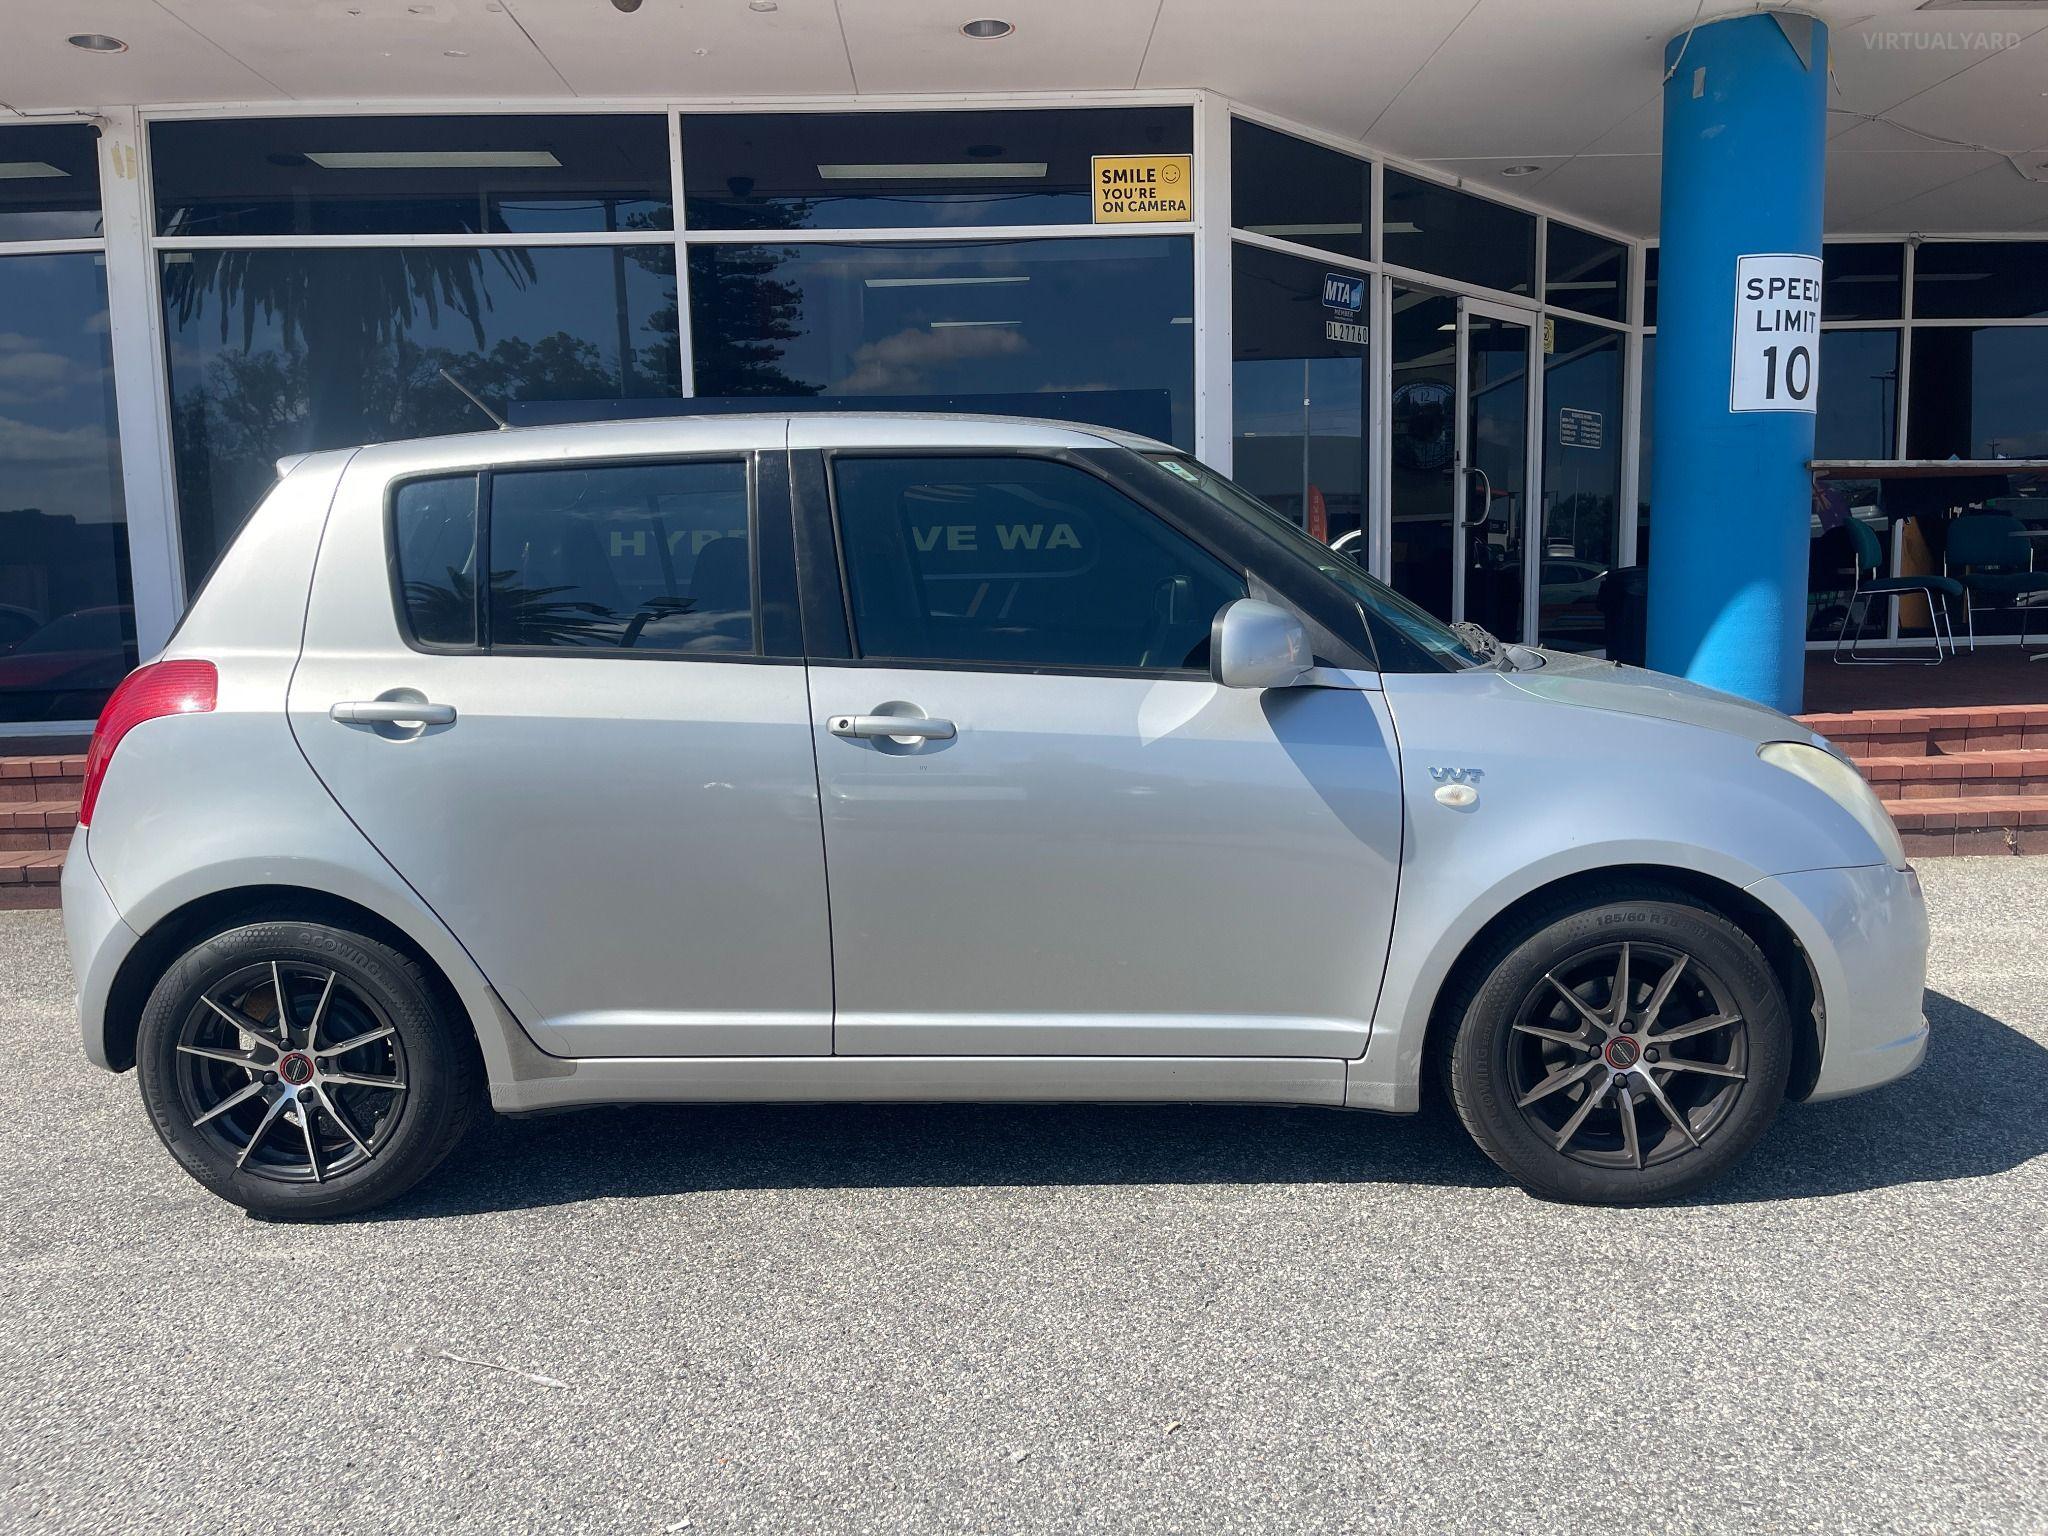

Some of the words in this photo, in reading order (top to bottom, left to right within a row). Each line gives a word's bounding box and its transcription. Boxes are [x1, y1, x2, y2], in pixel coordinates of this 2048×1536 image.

[1101, 168, 1156, 184] SMILE
[1102, 187, 1157, 200] YOU'RE
[1102, 201, 1124, 213] ON
[1128, 199, 1186, 212] CAMERA
[1325, 280, 1350, 304] MTA
[1746, 277, 1820, 303] SPEED
[1756, 309, 1816, 334] LIMIT
[1763, 345, 1811, 401] 10
[610, 530, 747, 557] HYP
[995, 523, 1083, 551] WA
[1597, 912, 1646, 926] 185/60
